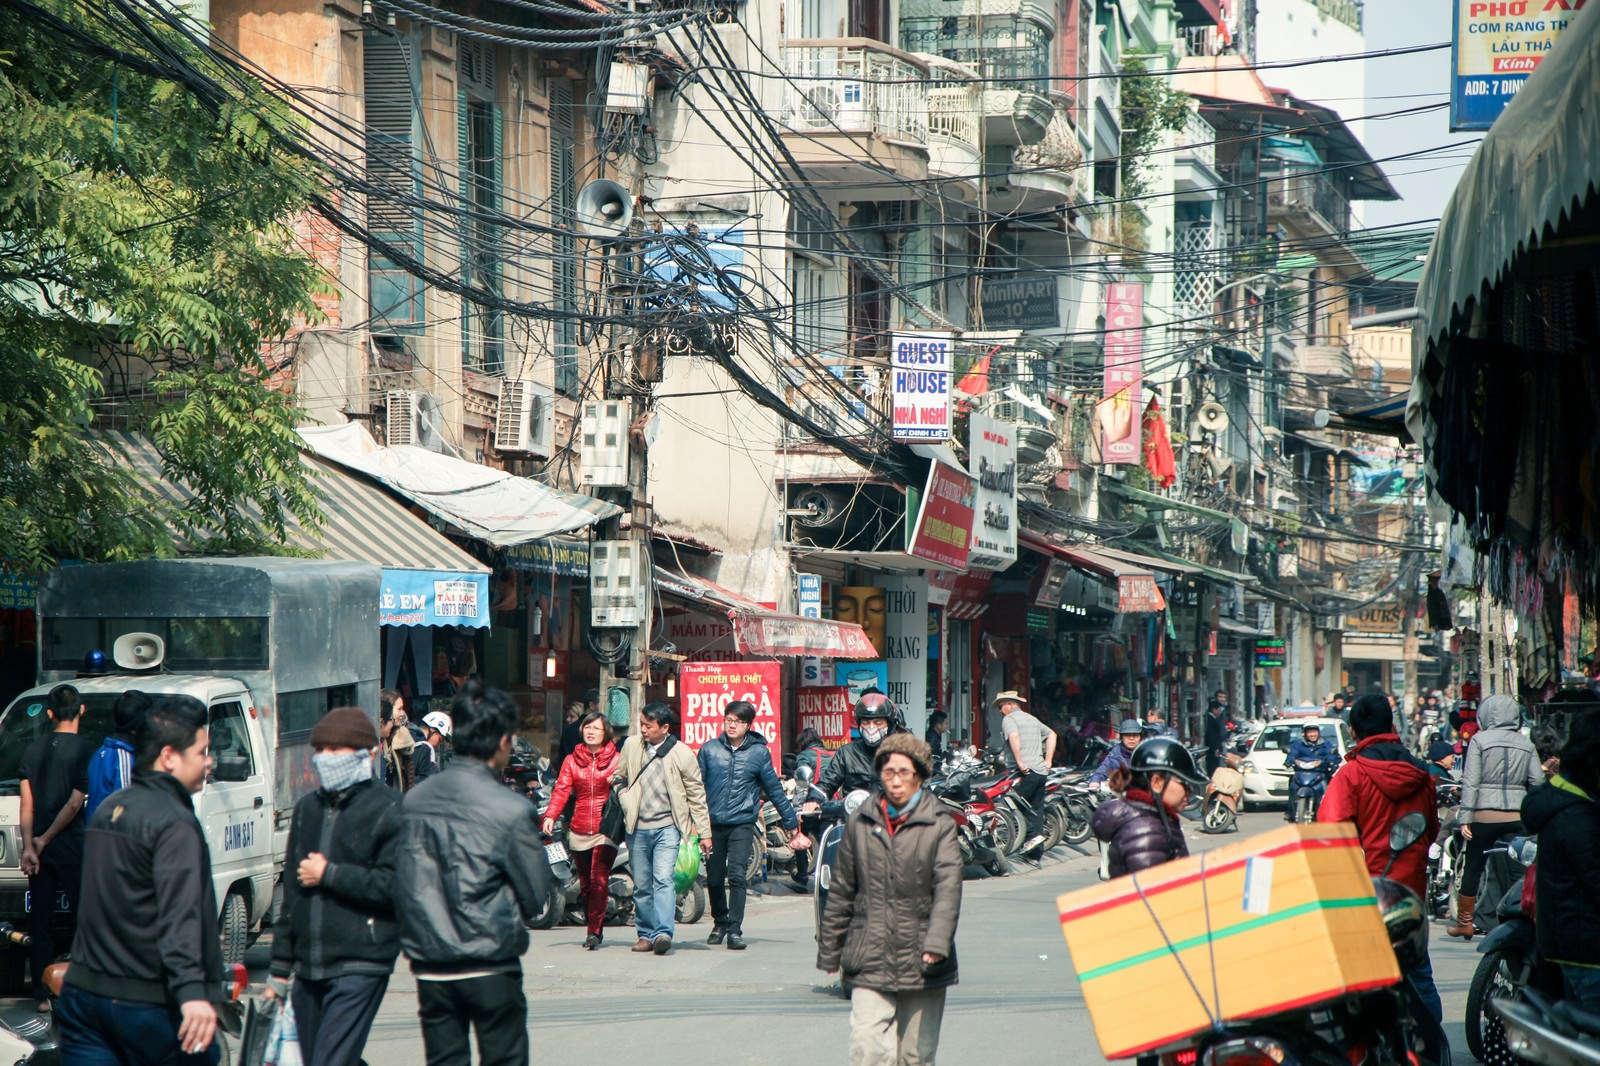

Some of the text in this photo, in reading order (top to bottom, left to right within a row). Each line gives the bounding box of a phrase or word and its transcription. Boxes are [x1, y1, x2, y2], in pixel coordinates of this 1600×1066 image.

[1505, 21, 1545, 32] RANG
[1498, 59, 1535, 70] Kính
[1465, 81, 1490, 96] ADD:
[1492, 81, 1499, 95] 7
[898, 342, 947, 364] GUEST
[896, 371, 947, 393] HOUSE
[894, 402, 948, 425] NHÀ NGHỈ
[801, 588, 820, 600] NGHỈ
[802, 577, 818, 589] NHÀ
[399, 594, 426, 609] EM
[437, 592, 456, 602] TÀI
[887, 636, 920, 659] RANG
[687, 684, 735, 717] PHỞ
[798, 687, 848, 713] BÚN CHẢ
[684, 716, 718, 744] BÚN
[803, 715, 823, 736] NEM
[824, 711, 843, 736] RÁN
